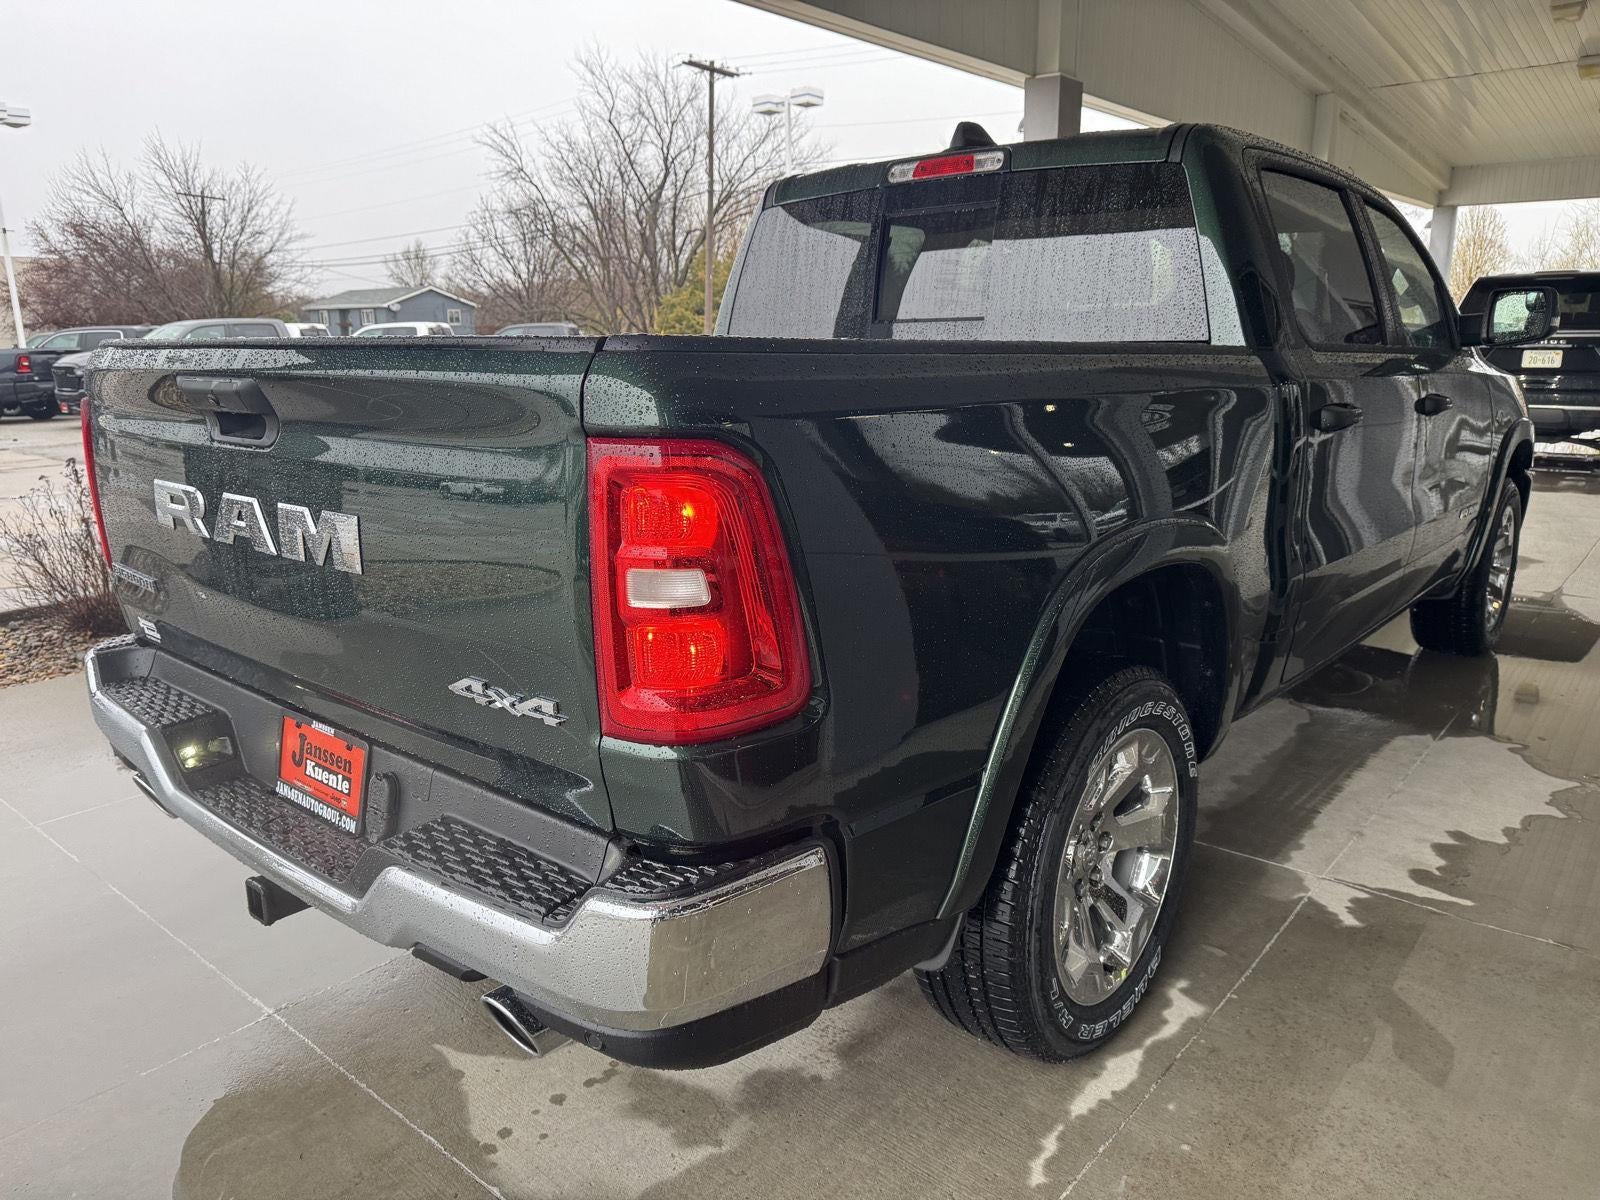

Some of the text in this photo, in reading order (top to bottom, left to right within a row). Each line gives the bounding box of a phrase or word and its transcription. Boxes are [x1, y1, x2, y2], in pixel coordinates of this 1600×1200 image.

[153, 478, 363, 575] RAM
[291, 733, 352, 775] Janssen
[305, 759, 350, 794] Kuenle
[1087, 701, 1198, 778] BRIDGESTONE
[1078, 945, 1162, 1040] DUELER
